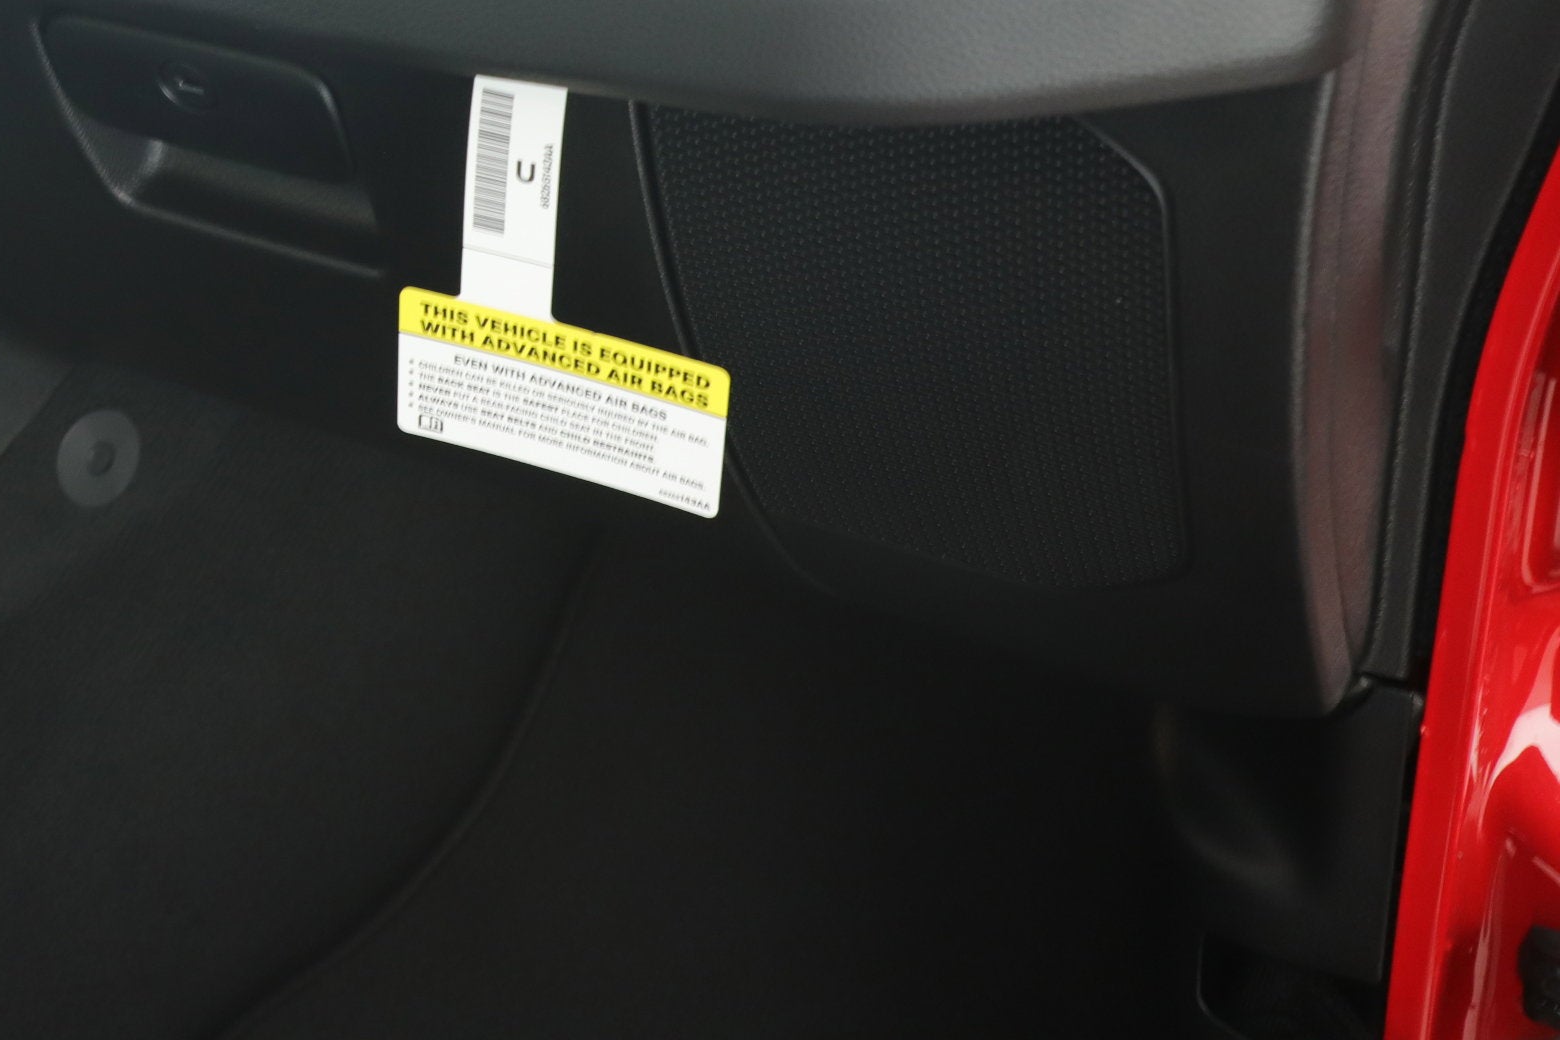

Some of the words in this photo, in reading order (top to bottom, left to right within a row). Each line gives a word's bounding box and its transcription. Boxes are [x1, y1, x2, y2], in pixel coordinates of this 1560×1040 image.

[420, 302, 468, 324] THIS
[476, 317, 565, 350] VEHICLE
[573, 343, 592, 357] IS
[599, 347, 711, 389] EQUIPPED
[420, 320, 474, 343] WITH
[482, 337, 600, 377] ADVANCED
[607, 371, 642, 388] AIR
[650, 382, 709, 407] BAGS
[454, 353, 487, 371] EVEN
[492, 364, 525, 381] WITH
[528, 374, 601, 402] ADVANCED
[604, 395, 627, 409] AIR
[631, 402, 667, 420] BAGS
